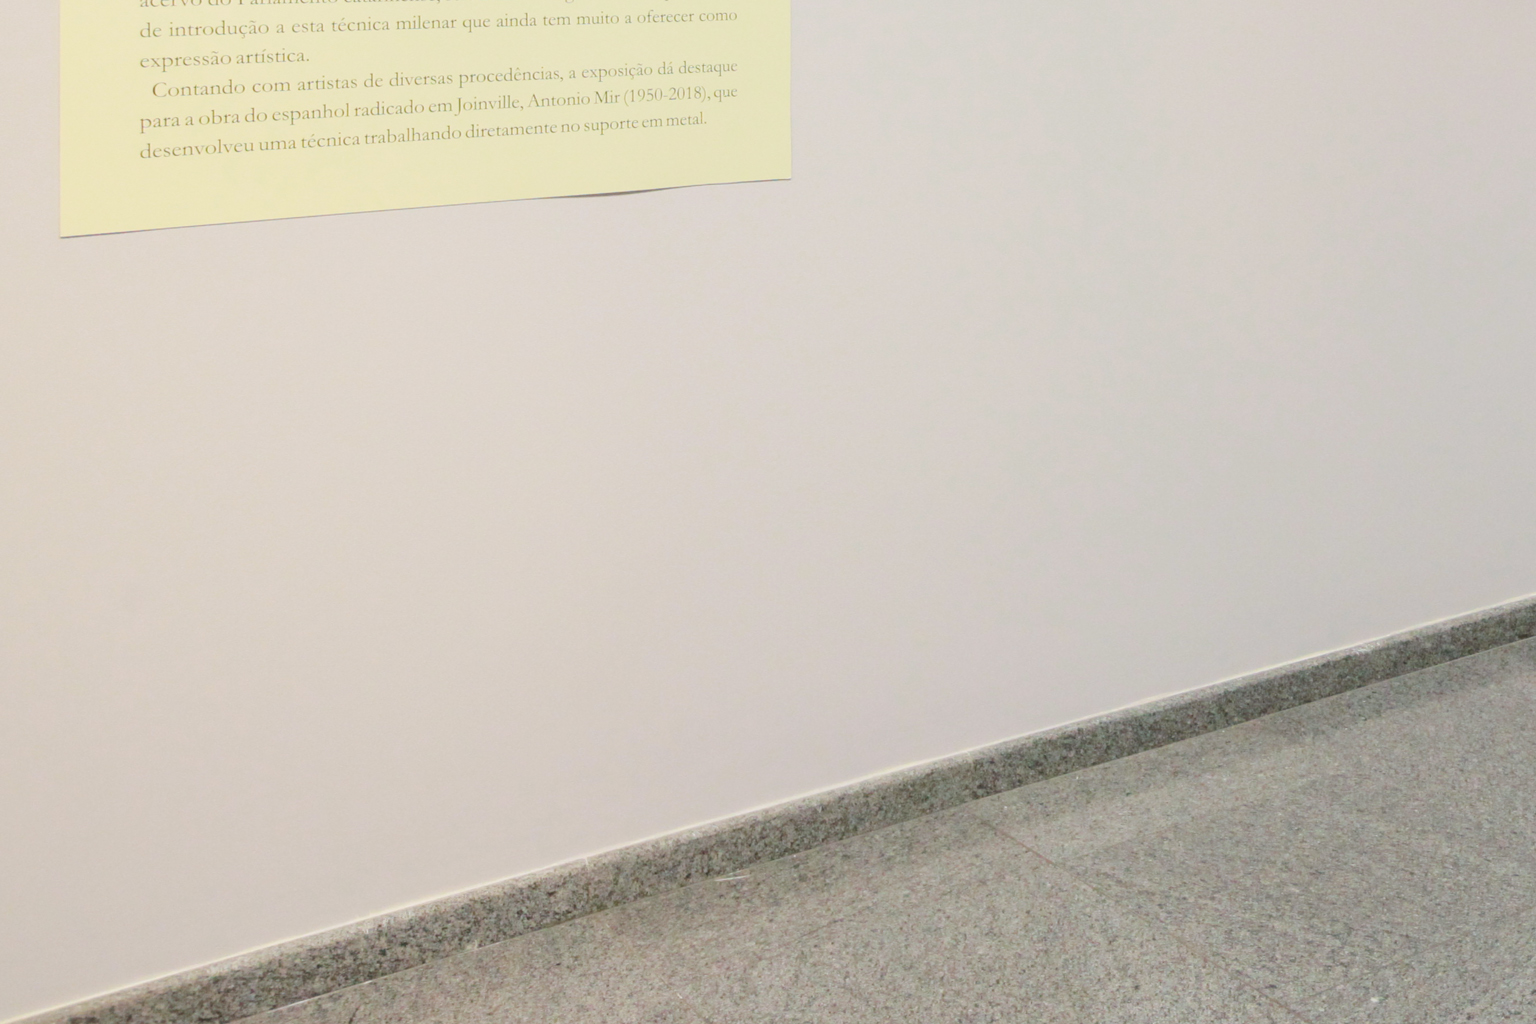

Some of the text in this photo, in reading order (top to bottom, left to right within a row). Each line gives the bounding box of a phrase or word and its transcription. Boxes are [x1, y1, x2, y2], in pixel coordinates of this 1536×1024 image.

[150, 59, 737, 98] Contando com artistas de diversas procedências, a exposição dá destaque
[139, 110, 707, 159] desenvolveu uma técnica trabalhando diretamente no suporte em metal.
